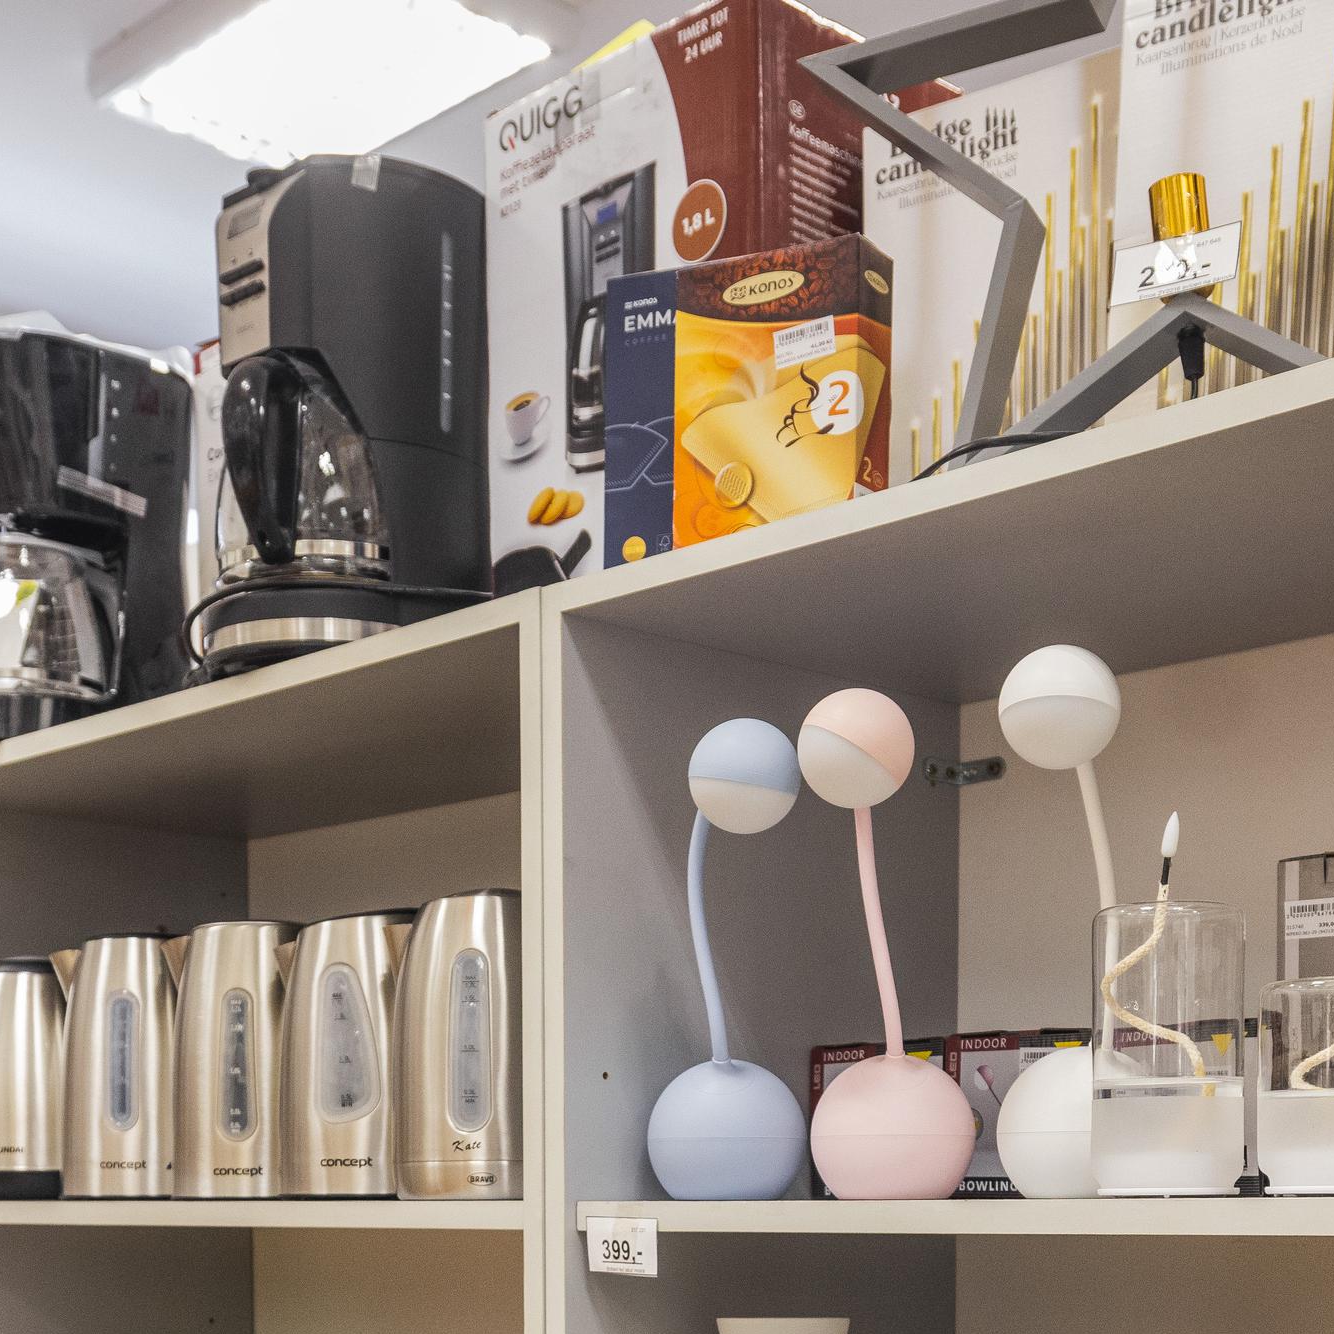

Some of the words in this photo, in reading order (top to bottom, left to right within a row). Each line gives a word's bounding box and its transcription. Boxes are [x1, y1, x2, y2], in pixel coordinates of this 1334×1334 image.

[677, 15, 710, 46] TIMER
[711, 7, 730, 32] TOT
[1250, 33, 1267, 48] de
[684, 46, 699, 63] 24
[700, 32, 723, 56] UUR
[499, 85, 583, 151] QUIGG
[624, 309, 677, 333] EMM
[828, 380, 850, 417] 2
[961, 1038, 1007, 1049] INDOOR
[823, 1050, 866, 1061] INDOOR
[451, 1140, 481, 1152] Kate
[99, 1160, 147, 1171] concept
[320, 1156, 373, 1168] concept
[213, 1165, 264, 1177] concept
[470, 1175, 495, 1184] BRAVO
[602, 1239, 643, 1264] 399,-
